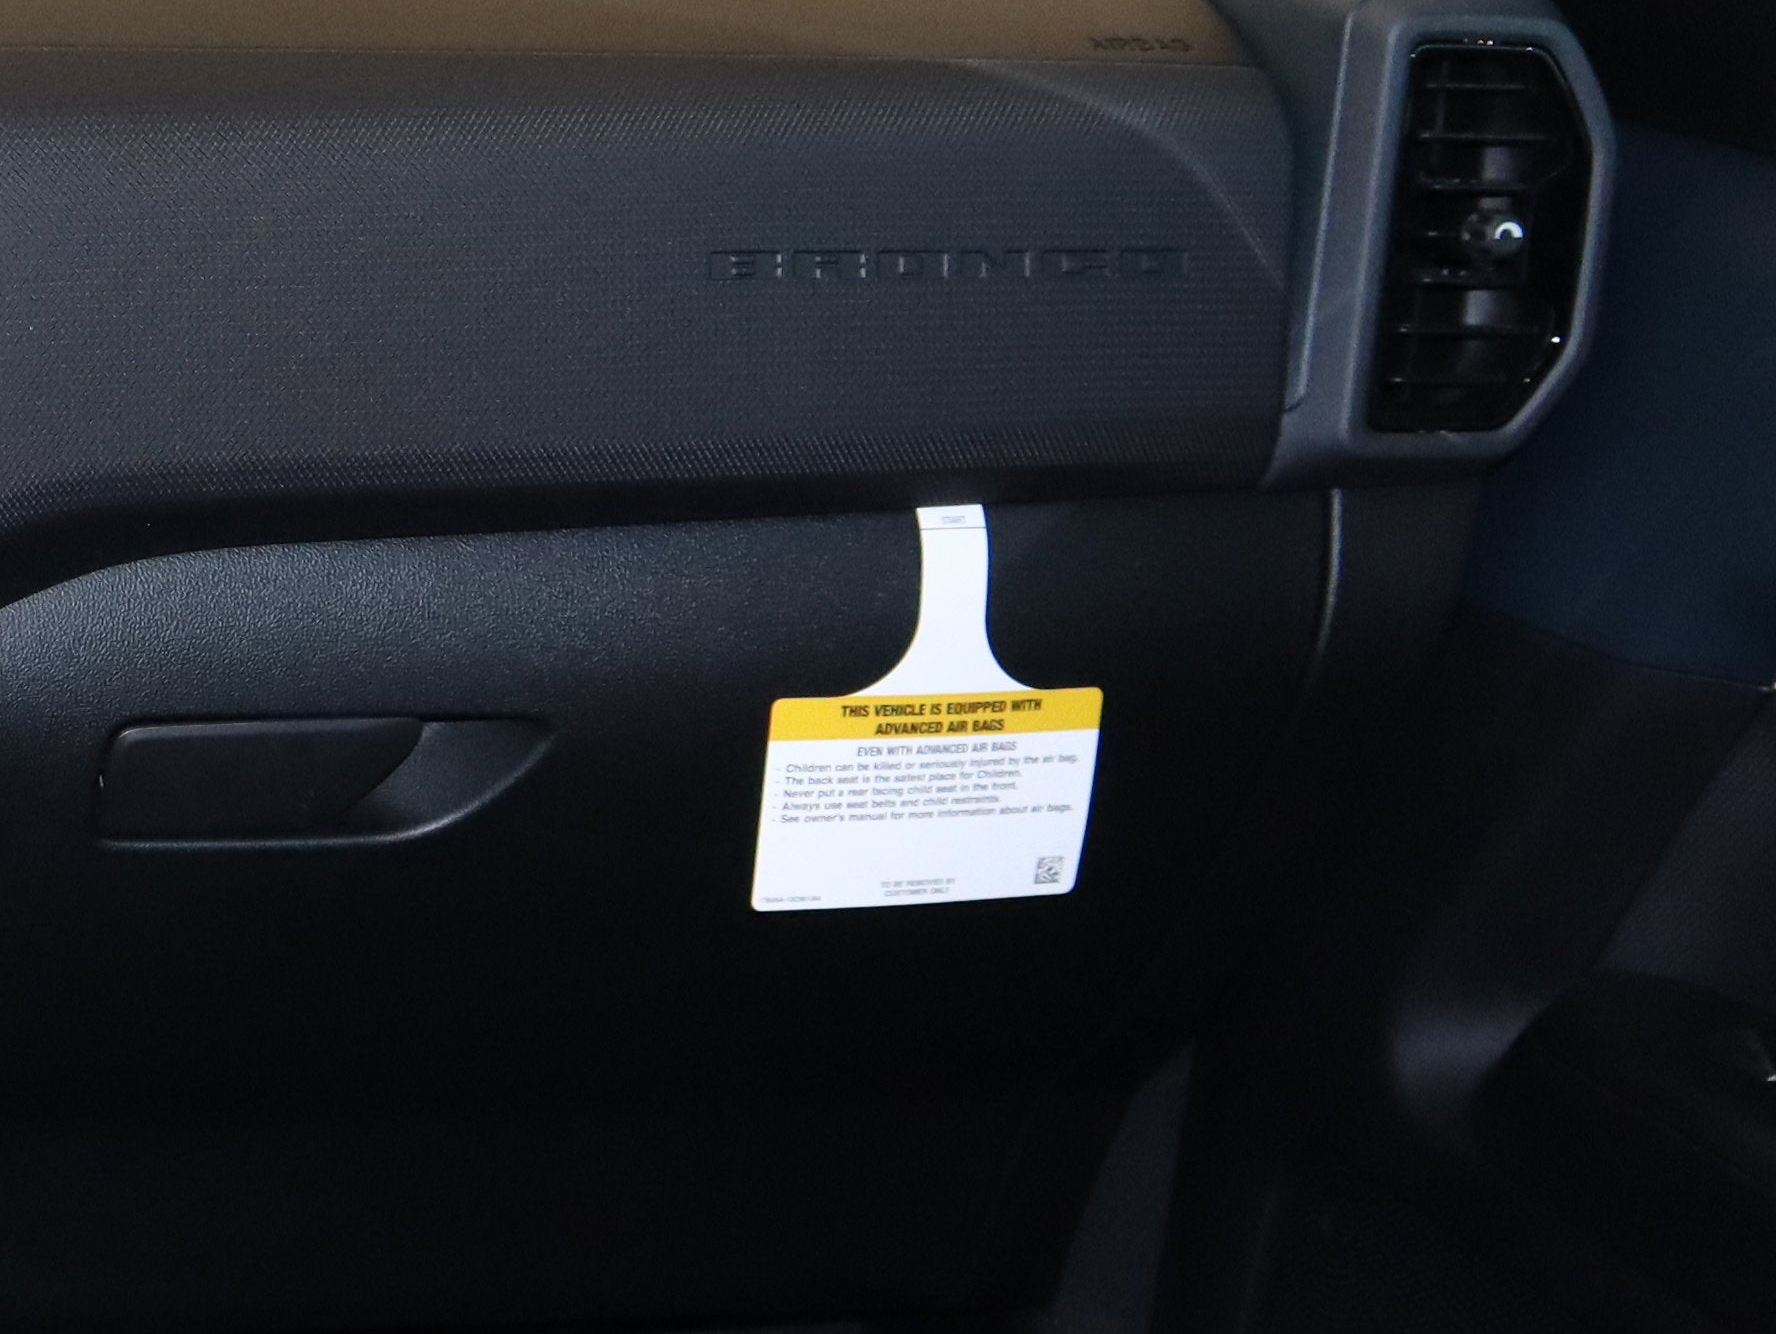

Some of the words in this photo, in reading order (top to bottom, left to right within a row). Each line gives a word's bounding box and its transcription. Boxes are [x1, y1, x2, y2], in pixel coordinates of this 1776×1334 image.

[841, 705, 870, 717] THIS
[875, 704, 927, 717] VEHICLE
[930, 703, 942, 715] IS
[946, 700, 1006, 715] EQUIPPED
[1011, 699, 1042, 711] WITH
[875, 722, 943, 735] ADVANCED
[947, 720, 968, 732] AIR
[972, 719, 1004, 731] BAGS
[857, 747, 882, 756] EVEN
[887, 746, 912, 755] WITH
[916, 744, 968, 754] ADVANCED
[972, 742, 987, 752] AIR
[786, 763, 832, 772] Children
[835, 764, 854, 772] can
[857, 763, 870, 771] be
[785, 777, 804, 785] The
[808, 776, 833, 785] back
[784, 789, 814, 798] Never
[818, 789, 835, 799] put
[782, 802, 820, 812] Always
[781, 814, 800, 823] See
